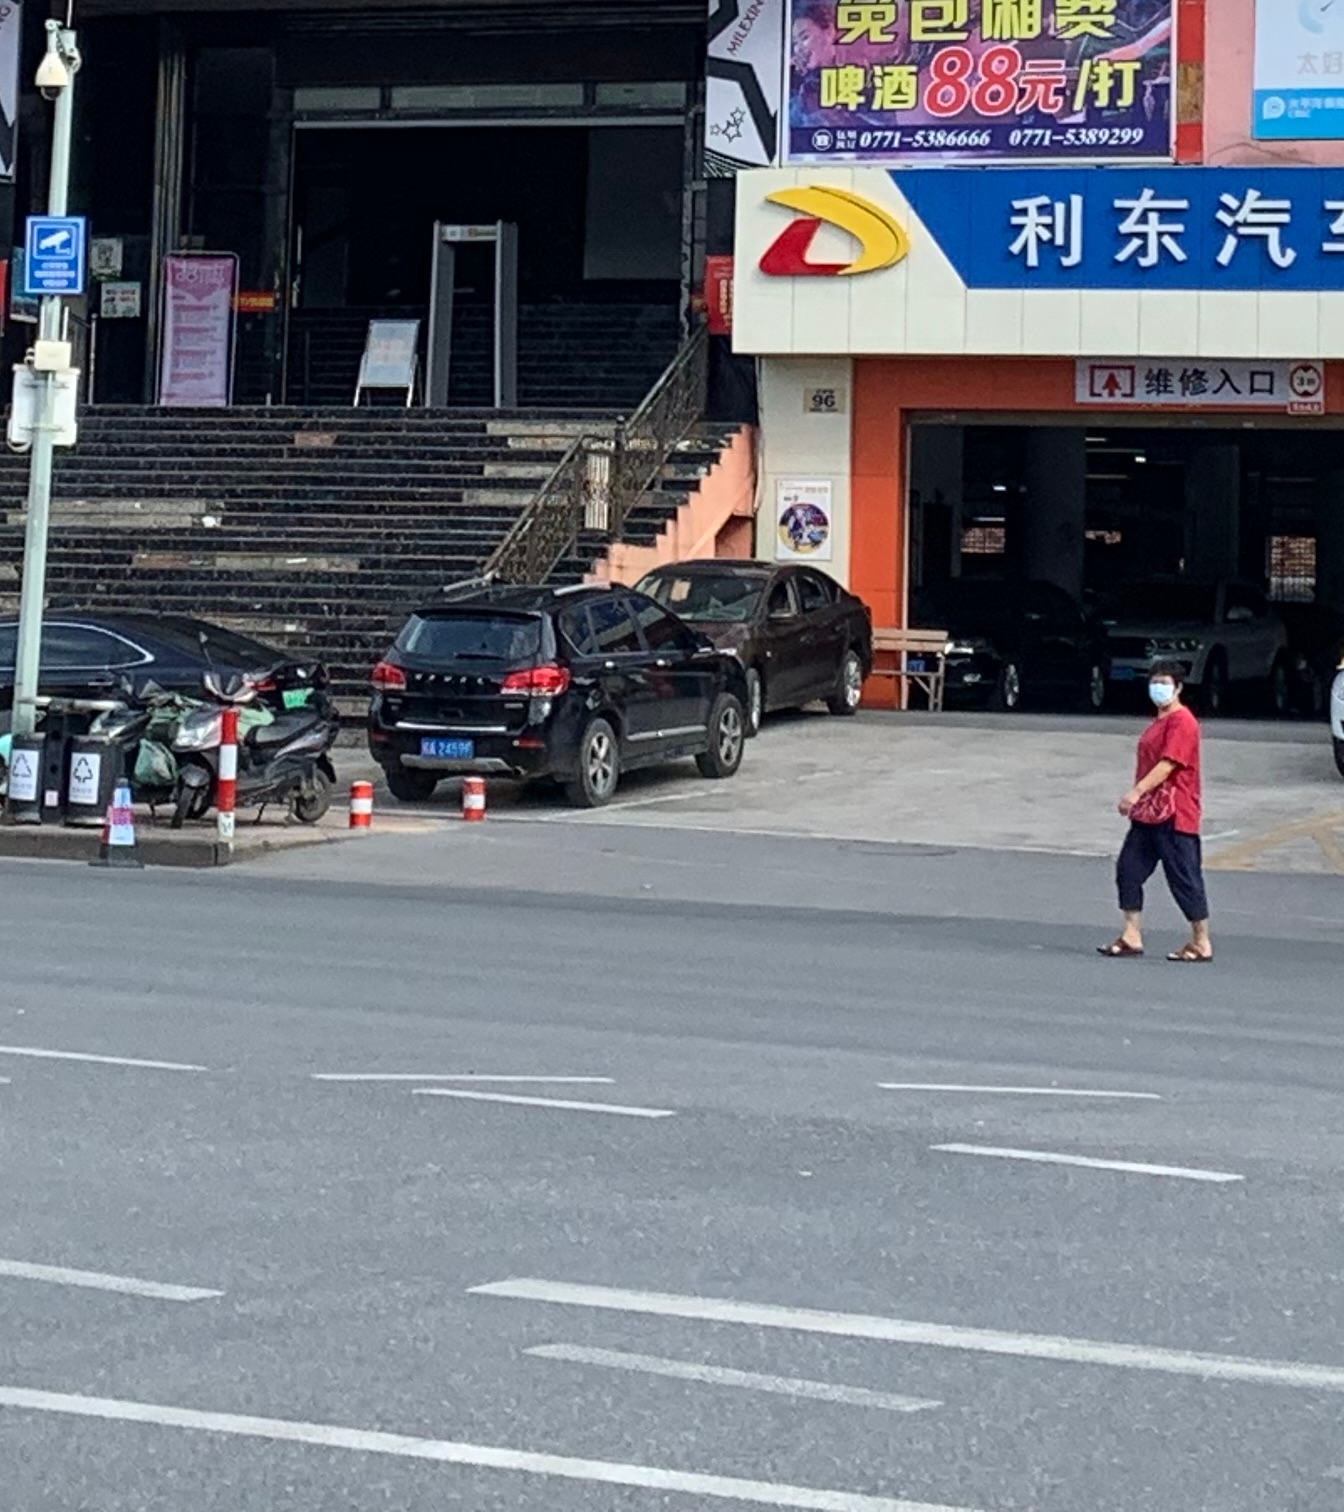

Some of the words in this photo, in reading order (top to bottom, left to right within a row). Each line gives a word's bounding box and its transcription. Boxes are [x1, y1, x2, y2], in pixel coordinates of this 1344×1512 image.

[859, 129, 992, 148] 0771-5386666
[1009, 127, 1144, 146] 0771-5389299
[1144, 367, 1275, 396] 维修入口
